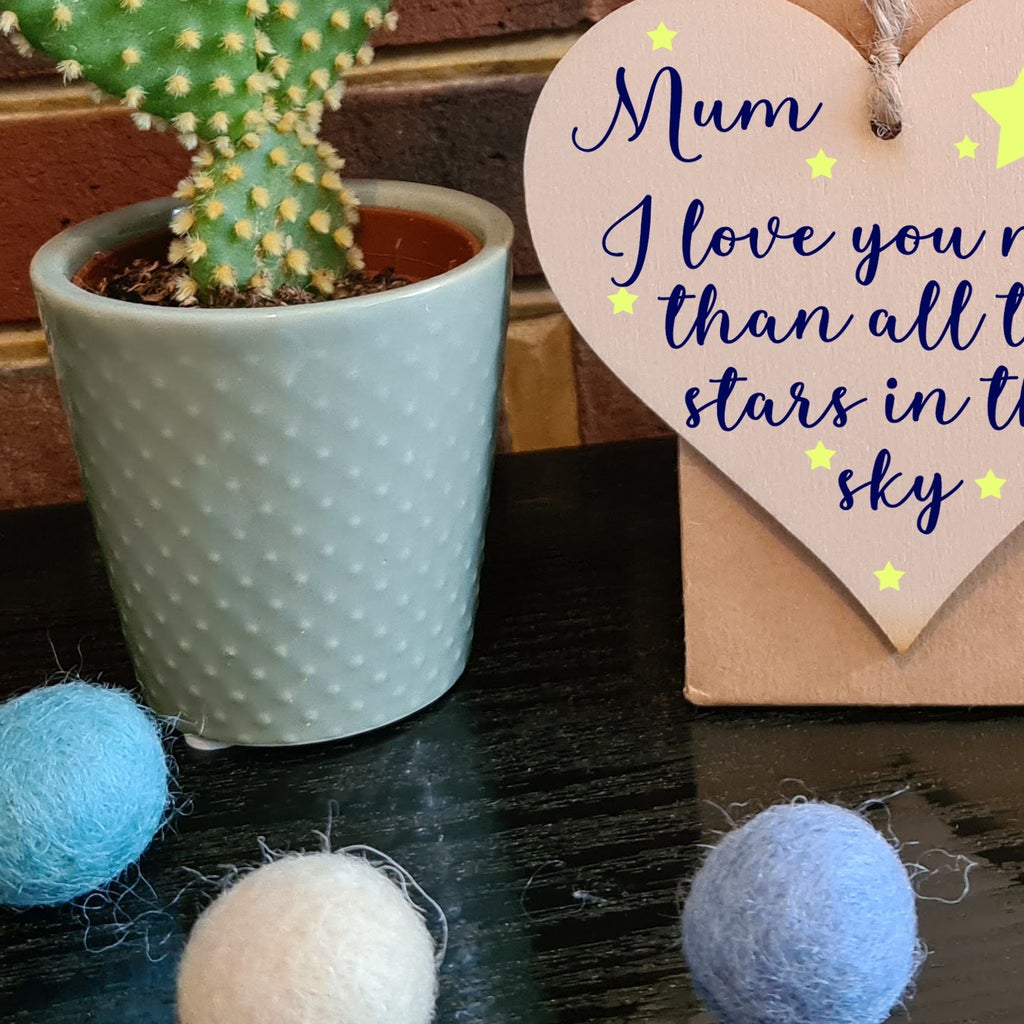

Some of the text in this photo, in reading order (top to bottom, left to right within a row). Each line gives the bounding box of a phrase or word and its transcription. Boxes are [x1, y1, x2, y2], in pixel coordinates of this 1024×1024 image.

[571, 66, 823, 163] Mum
[602, 195, 652, 287] I
[682, 199, 836, 270] love
[852, 224, 986, 286] you
[657, 284, 854, 350] than
[868, 280, 987, 351] all
[685, 367, 868, 432] stars
[885, 377, 971, 426] in
[838, 449, 964, 535] sky
